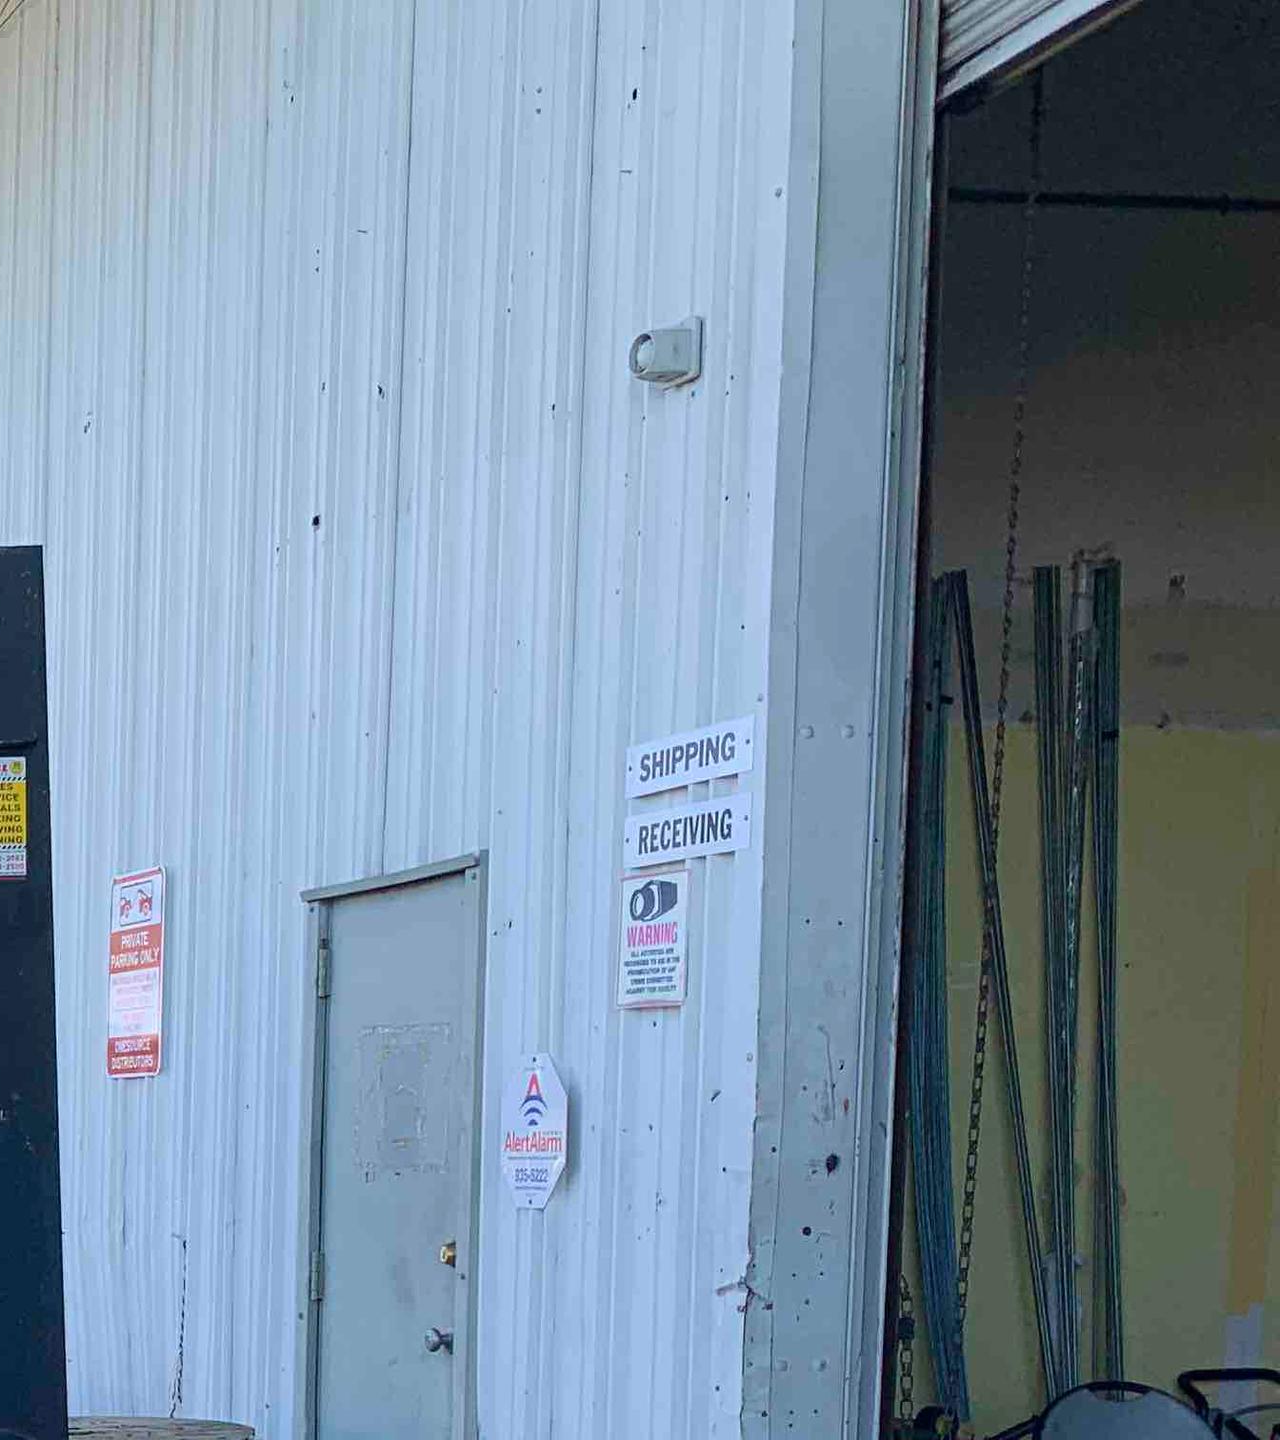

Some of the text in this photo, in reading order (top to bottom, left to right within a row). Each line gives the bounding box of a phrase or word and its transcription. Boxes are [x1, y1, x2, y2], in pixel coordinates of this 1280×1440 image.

[639, 732, 736, 782] SHIPPING
[638, 808, 732, 855] RECEIVING
[121, 931, 150, 950] PRIVATE
[626, 921, 678, 948] WARNING
[111, 946, 160, 968] PARKING ONLY
